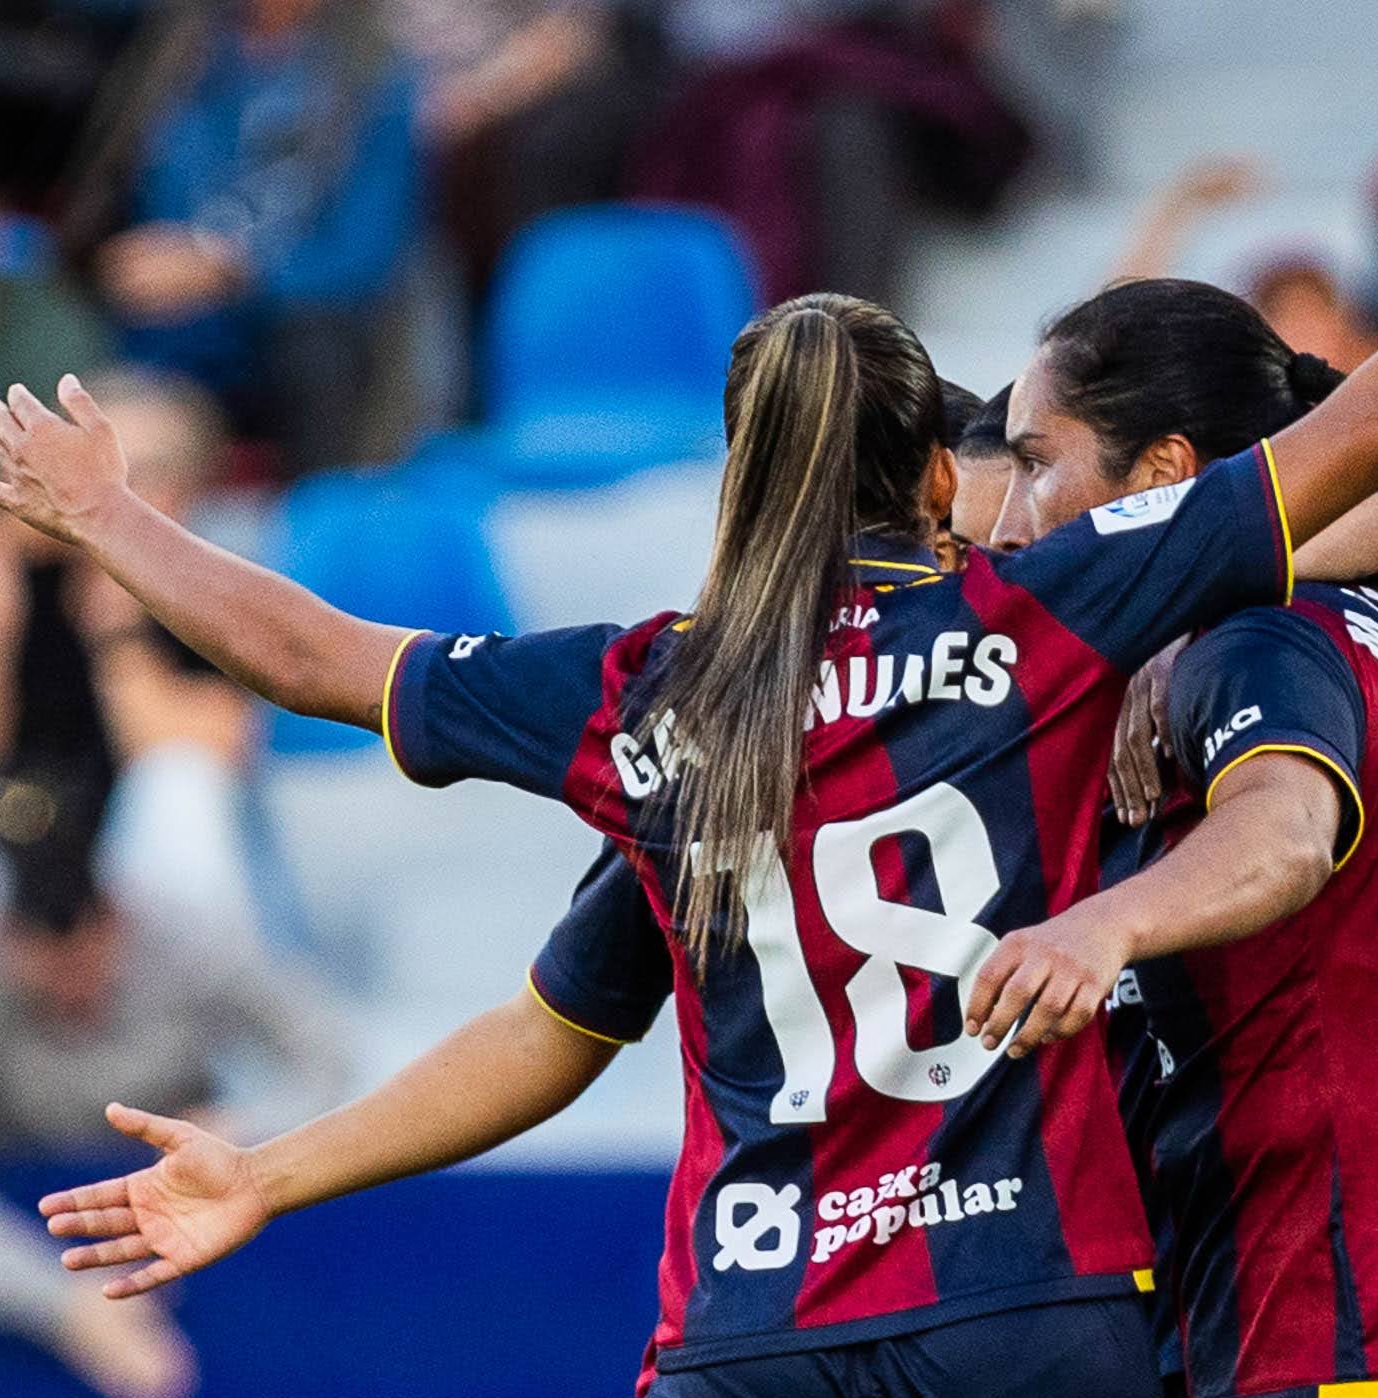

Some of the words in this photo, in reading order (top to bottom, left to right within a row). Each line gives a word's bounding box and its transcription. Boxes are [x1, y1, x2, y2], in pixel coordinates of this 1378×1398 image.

[689, 780, 1021, 1124] 18
[810, 1176, 1023, 1264] popular
[817, 1161, 943, 1222] caixa
